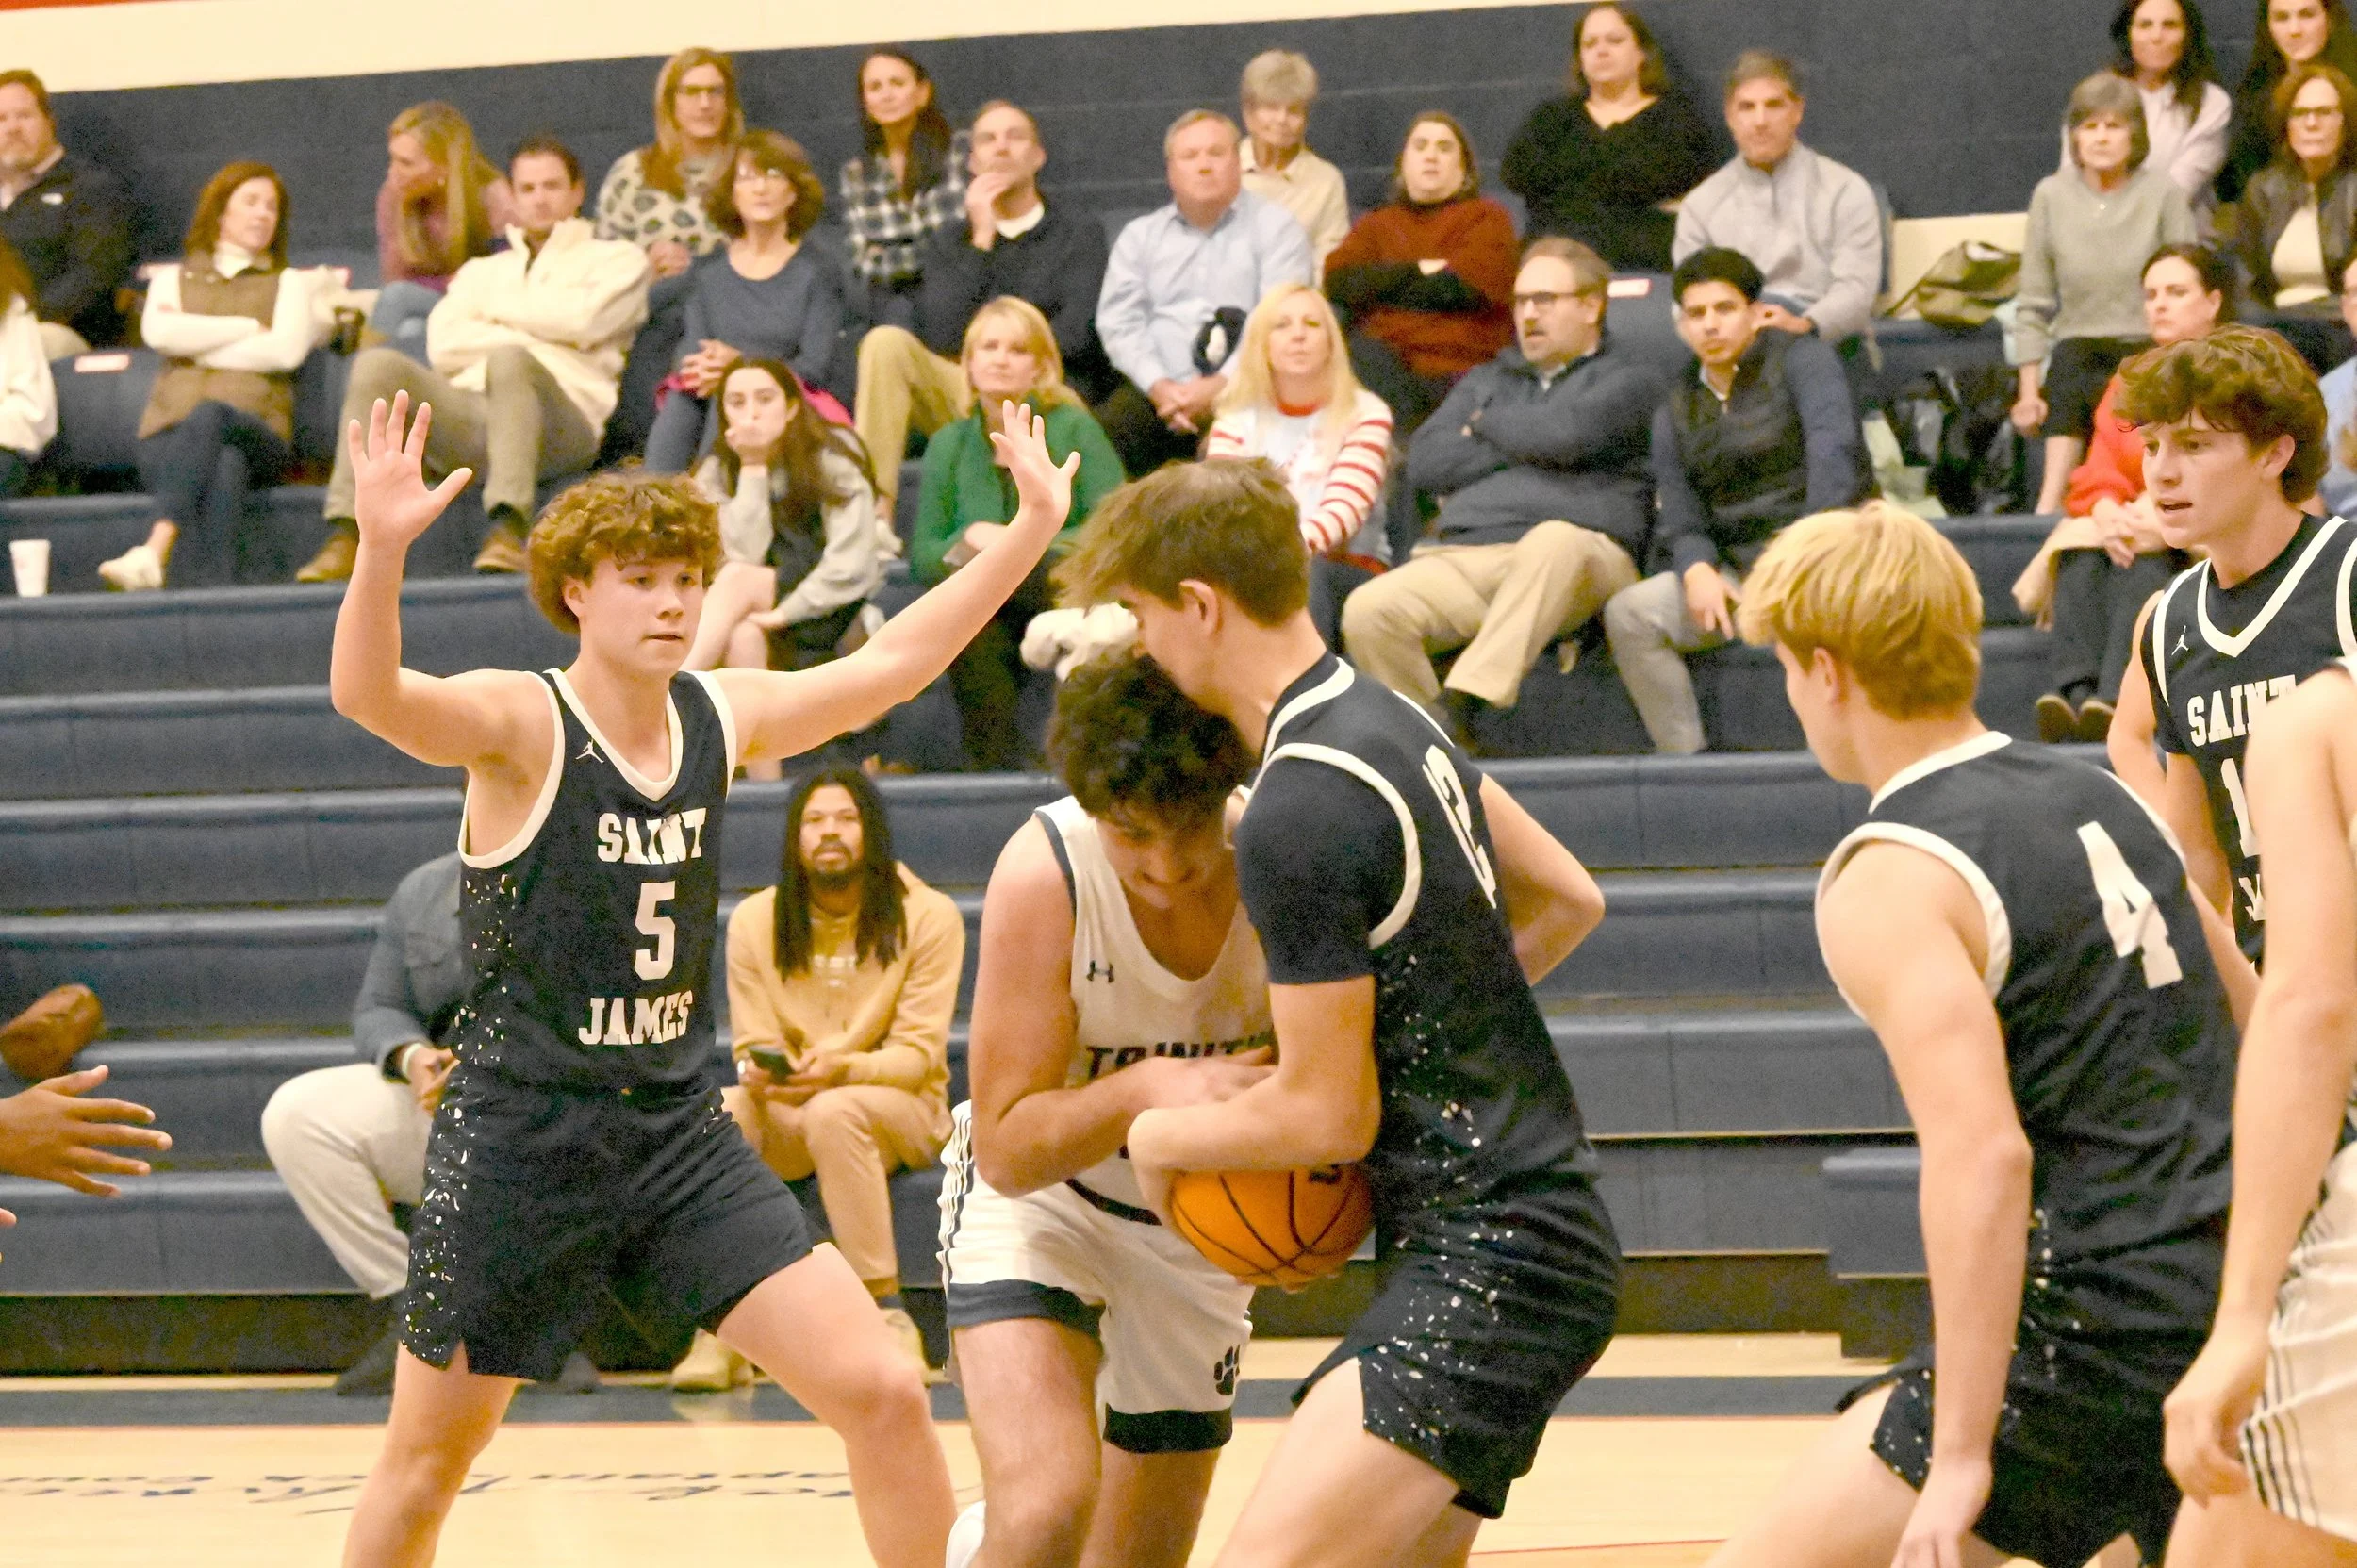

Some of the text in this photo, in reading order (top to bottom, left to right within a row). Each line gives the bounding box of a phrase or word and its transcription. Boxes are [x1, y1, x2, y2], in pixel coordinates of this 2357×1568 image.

[598, 807, 706, 866] SAINT
[1422, 744, 1497, 910] 12
[635, 880, 676, 981] 5
[2077, 820, 2184, 990] 4
[578, 990, 693, 1046] JAMES
